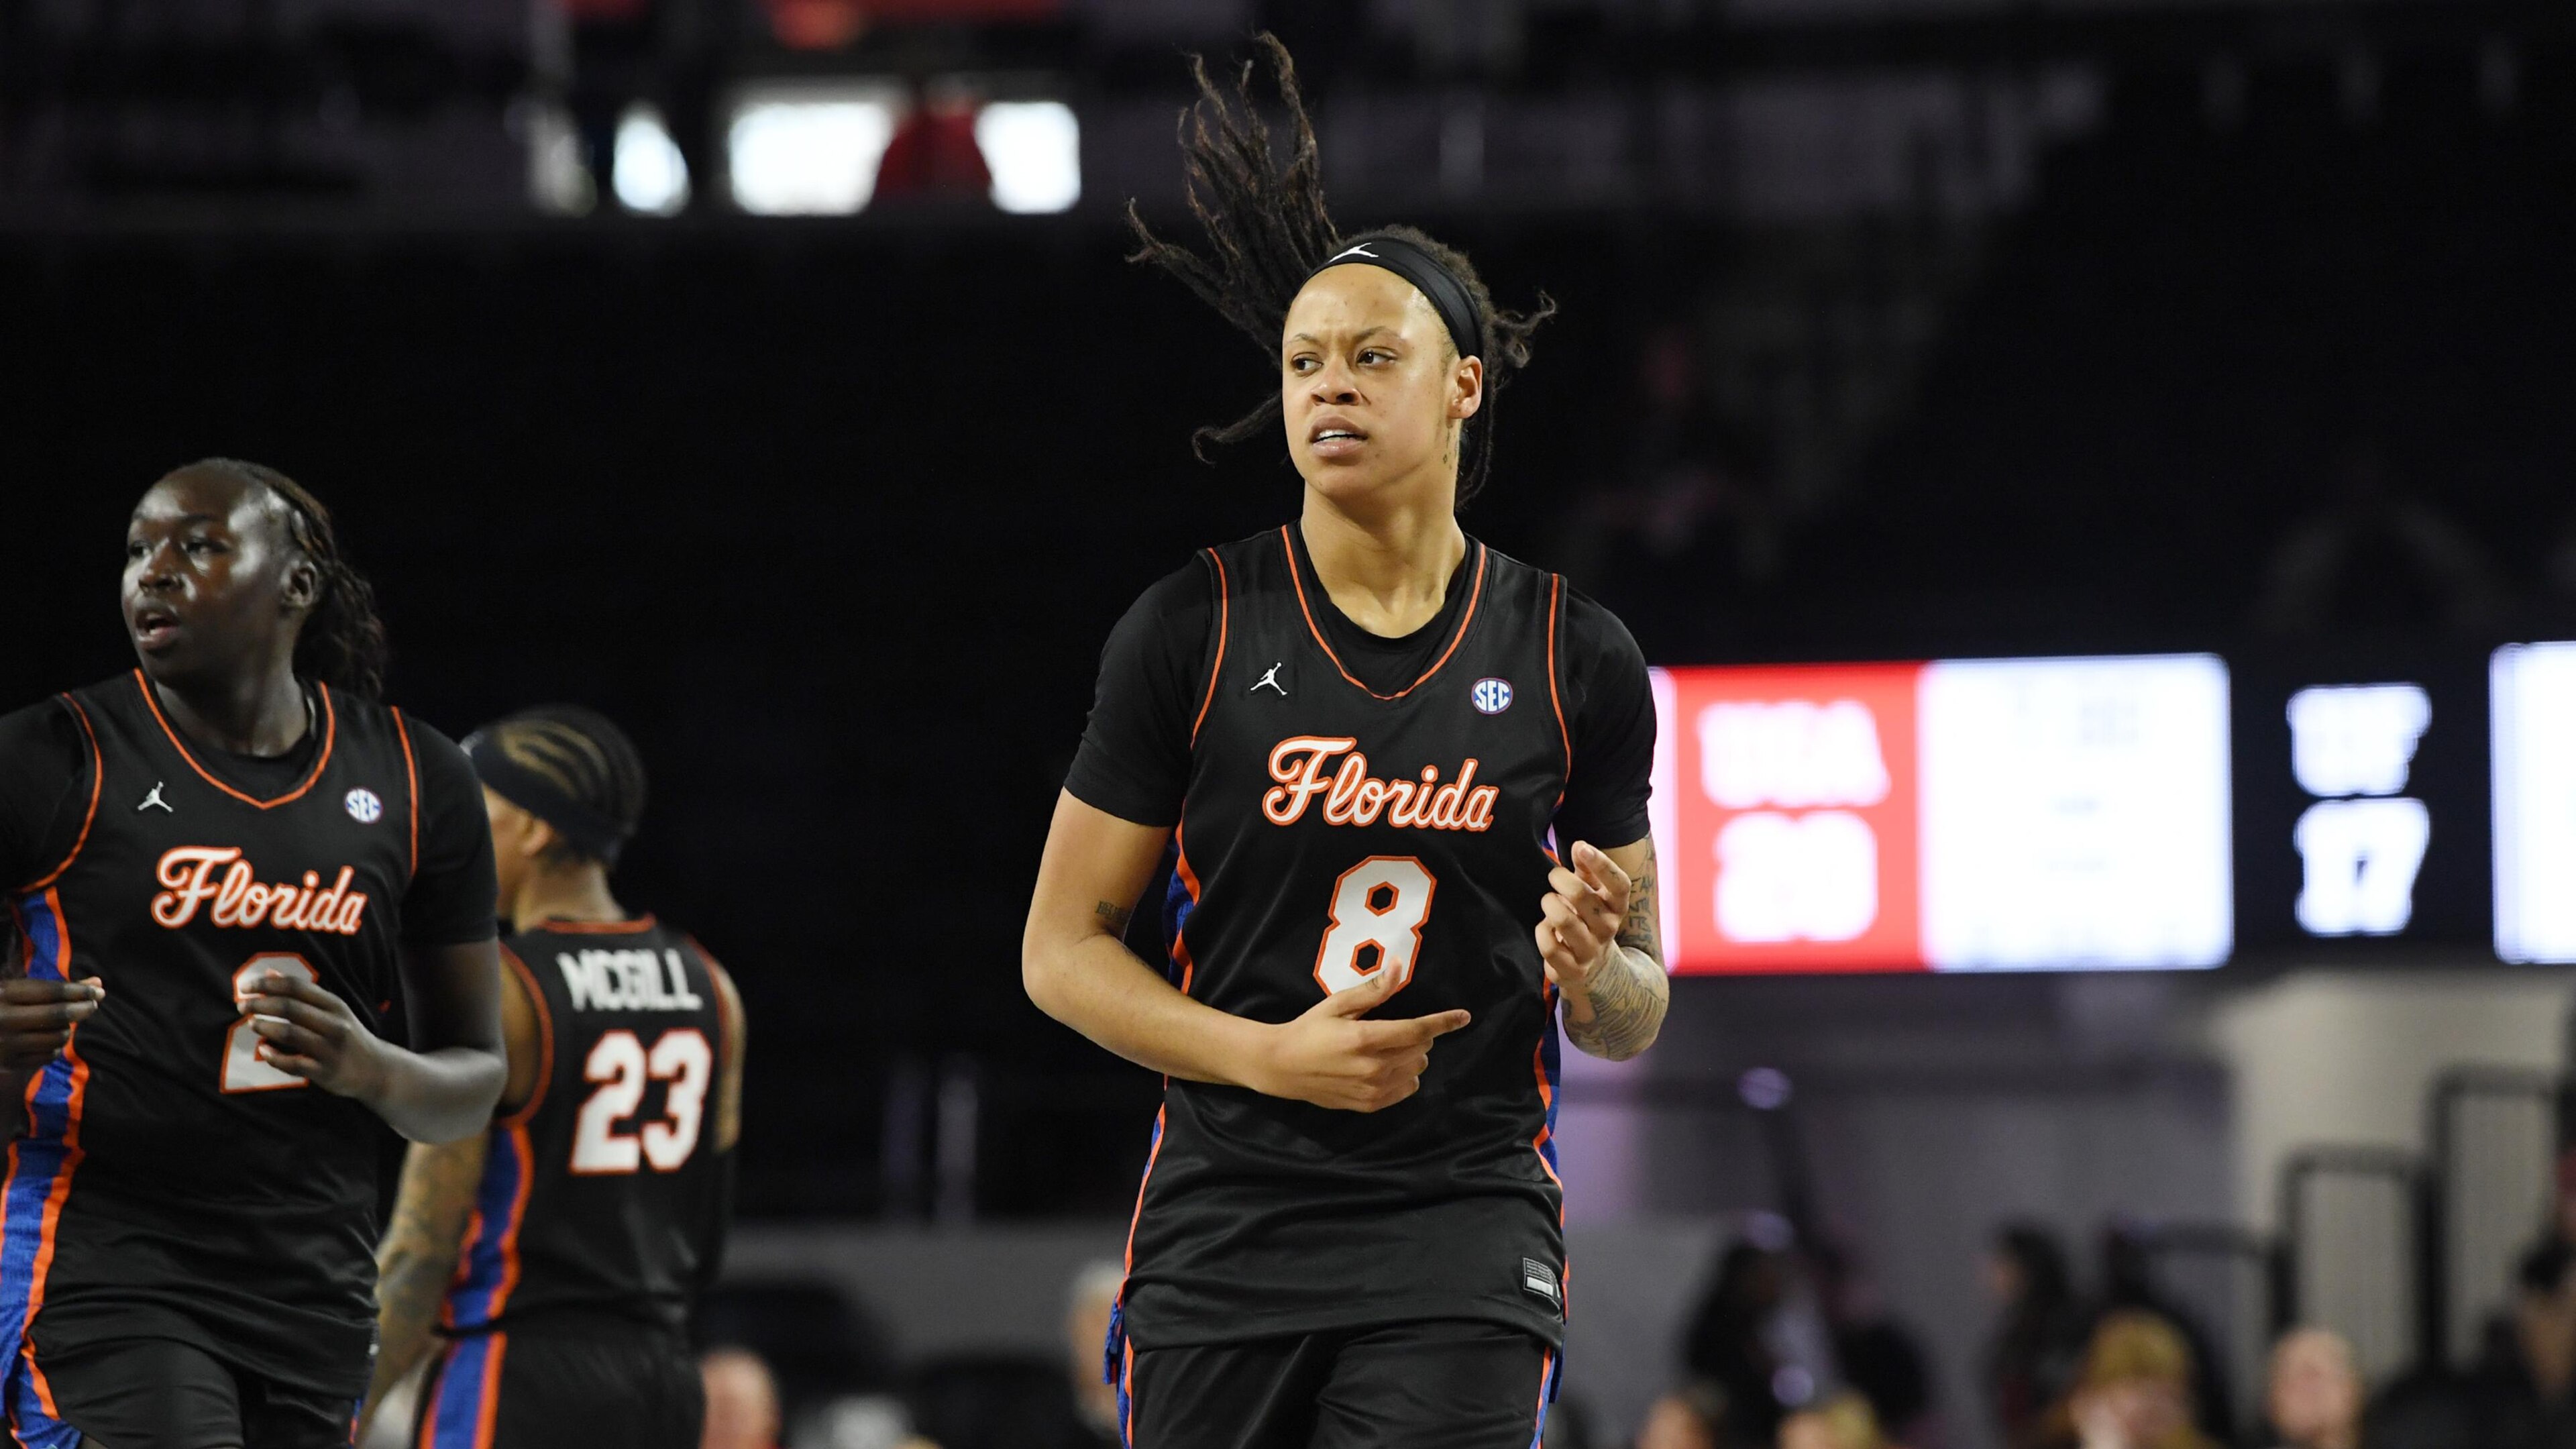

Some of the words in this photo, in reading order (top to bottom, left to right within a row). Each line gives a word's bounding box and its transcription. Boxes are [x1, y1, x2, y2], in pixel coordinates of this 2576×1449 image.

[1473, 679, 1511, 712] SEC
[345, 788, 382, 823] SEC
[1262, 735, 1499, 832] Florida
[152, 845, 368, 935] Florida
[1312, 855, 1438, 998] 8
[219, 951, 319, 1094] 2
[556, 947, 703, 1011] MCGILL
[568, 1027, 714, 1177] 23
